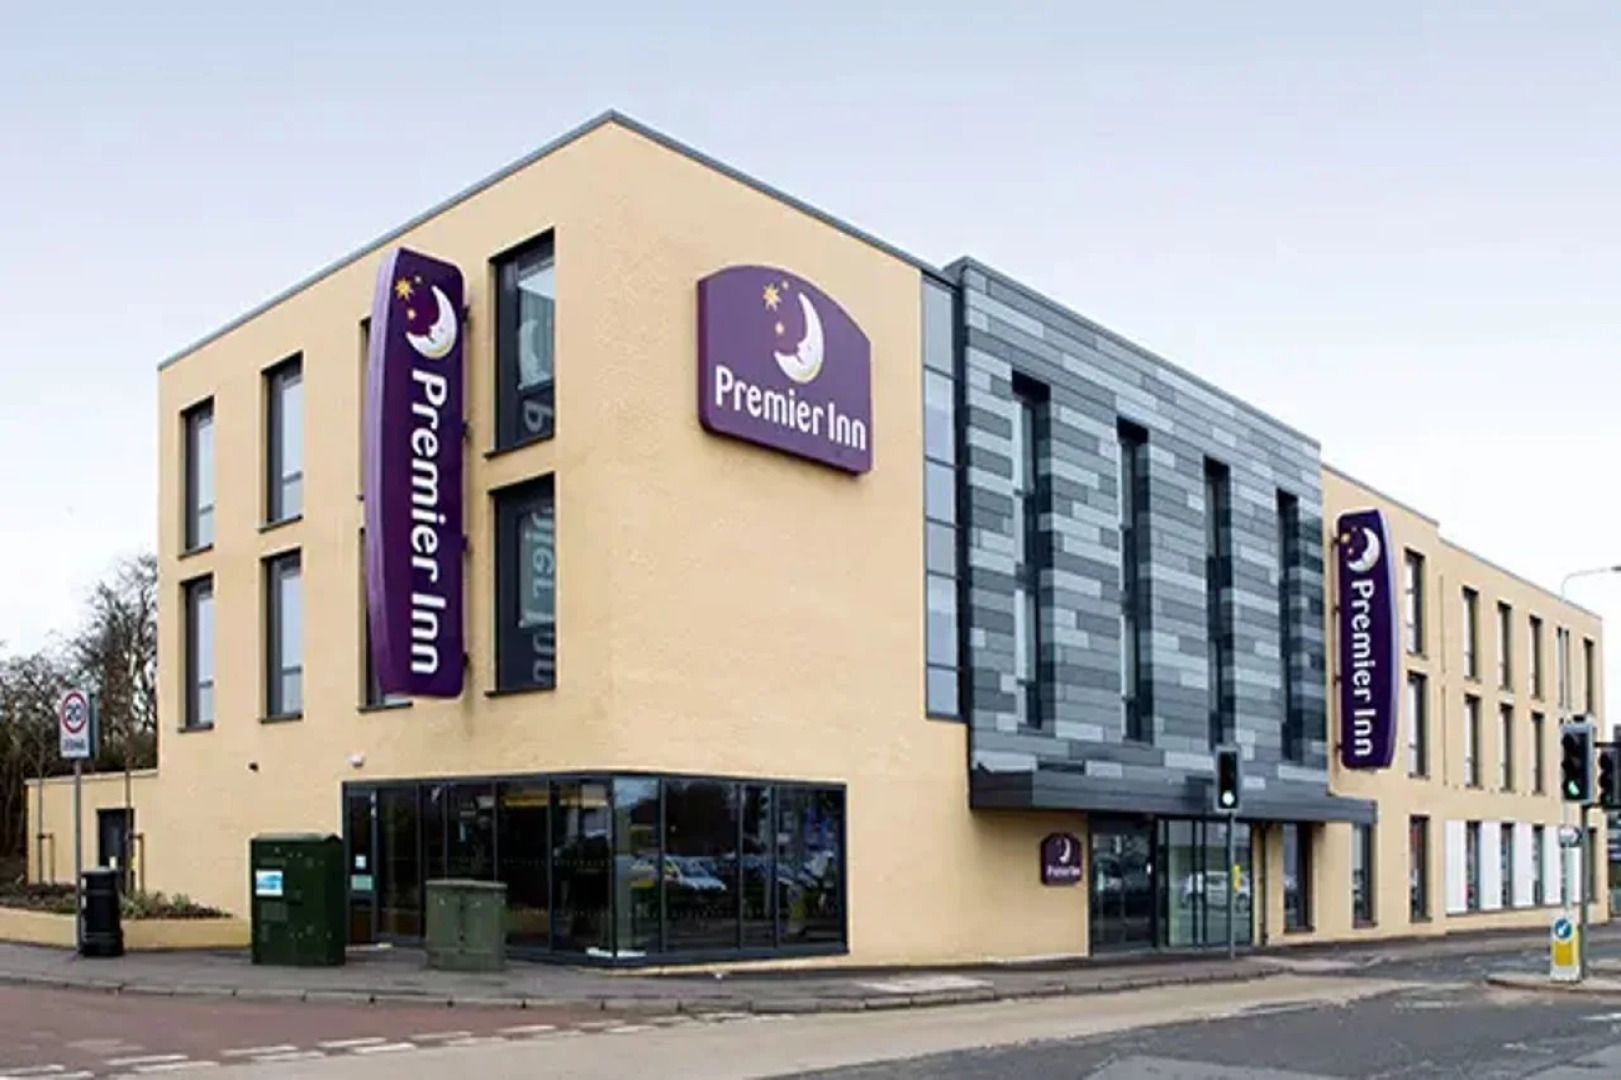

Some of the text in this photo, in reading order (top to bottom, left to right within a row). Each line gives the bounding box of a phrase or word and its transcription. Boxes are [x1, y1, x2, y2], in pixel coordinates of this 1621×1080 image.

[715, 364, 867, 450] Premier Inn
[411, 369, 447, 674] Premier Inn
[1351, 578, 1376, 756] Premier Inn
